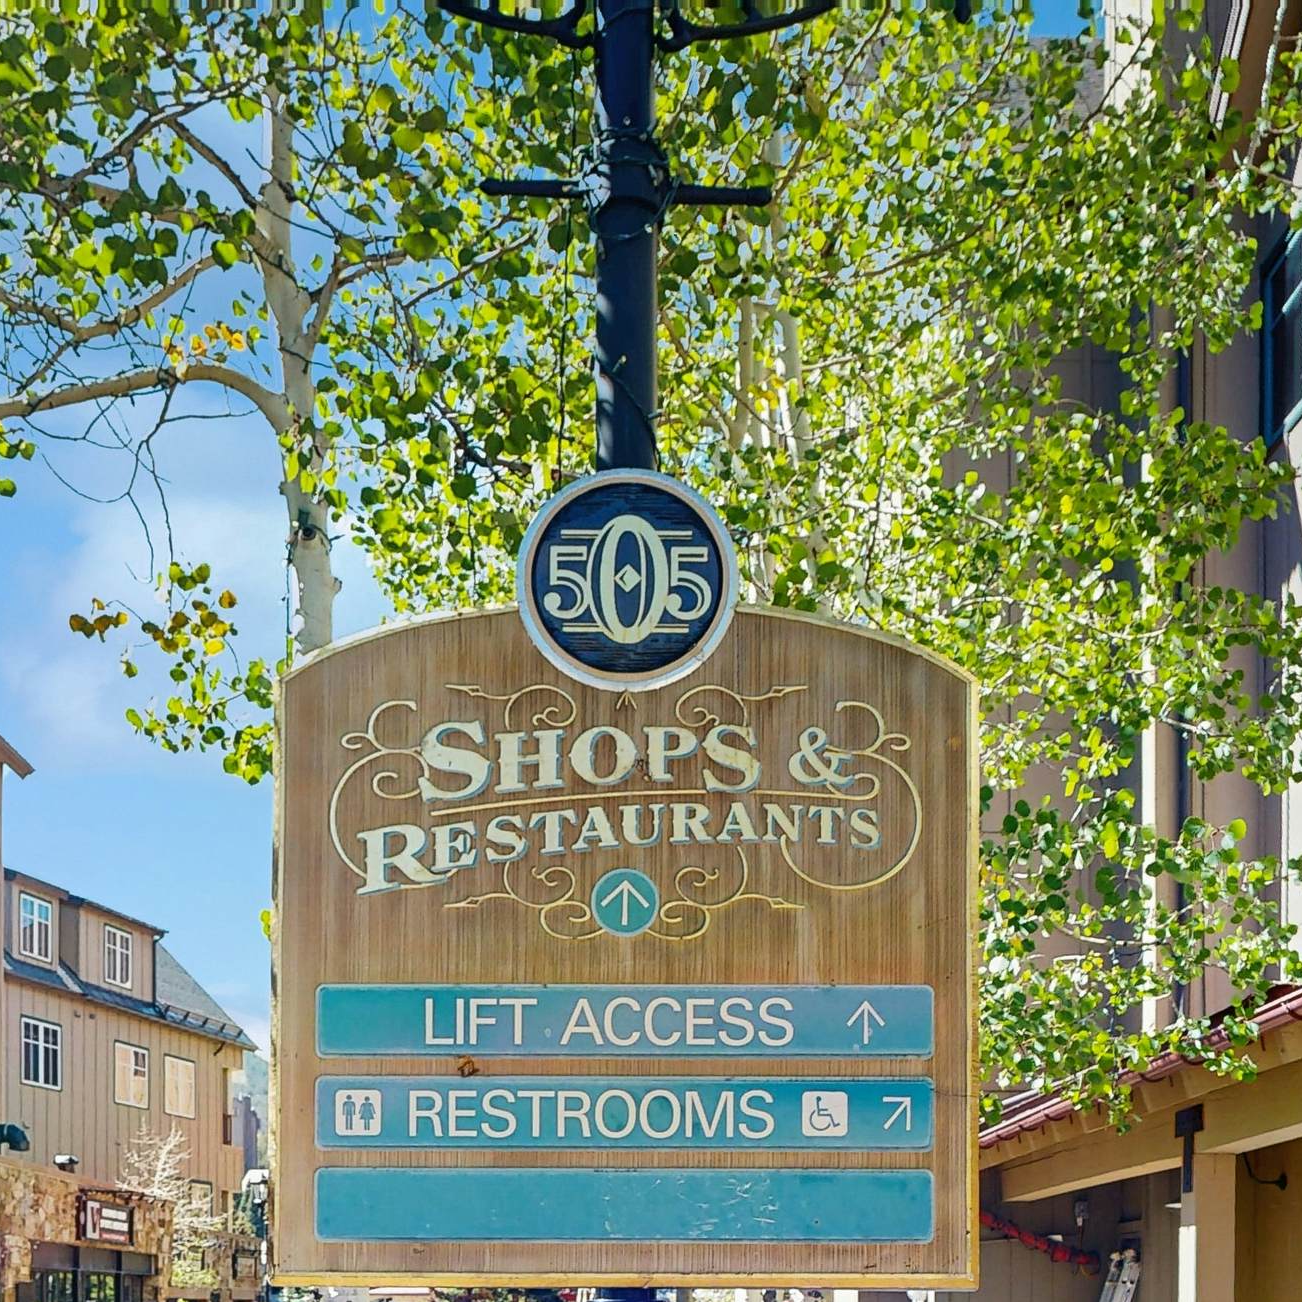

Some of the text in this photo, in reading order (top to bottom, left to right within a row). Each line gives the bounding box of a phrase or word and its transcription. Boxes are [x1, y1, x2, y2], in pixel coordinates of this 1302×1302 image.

[543, 514, 712, 644] 505
[419, 720, 856, 803] SHOPS &
[356, 803, 882, 895] RESTAURANTS
[424, 997, 796, 1046] LIFT ACCESS
[407, 1089, 775, 1139] RESTROOMS
